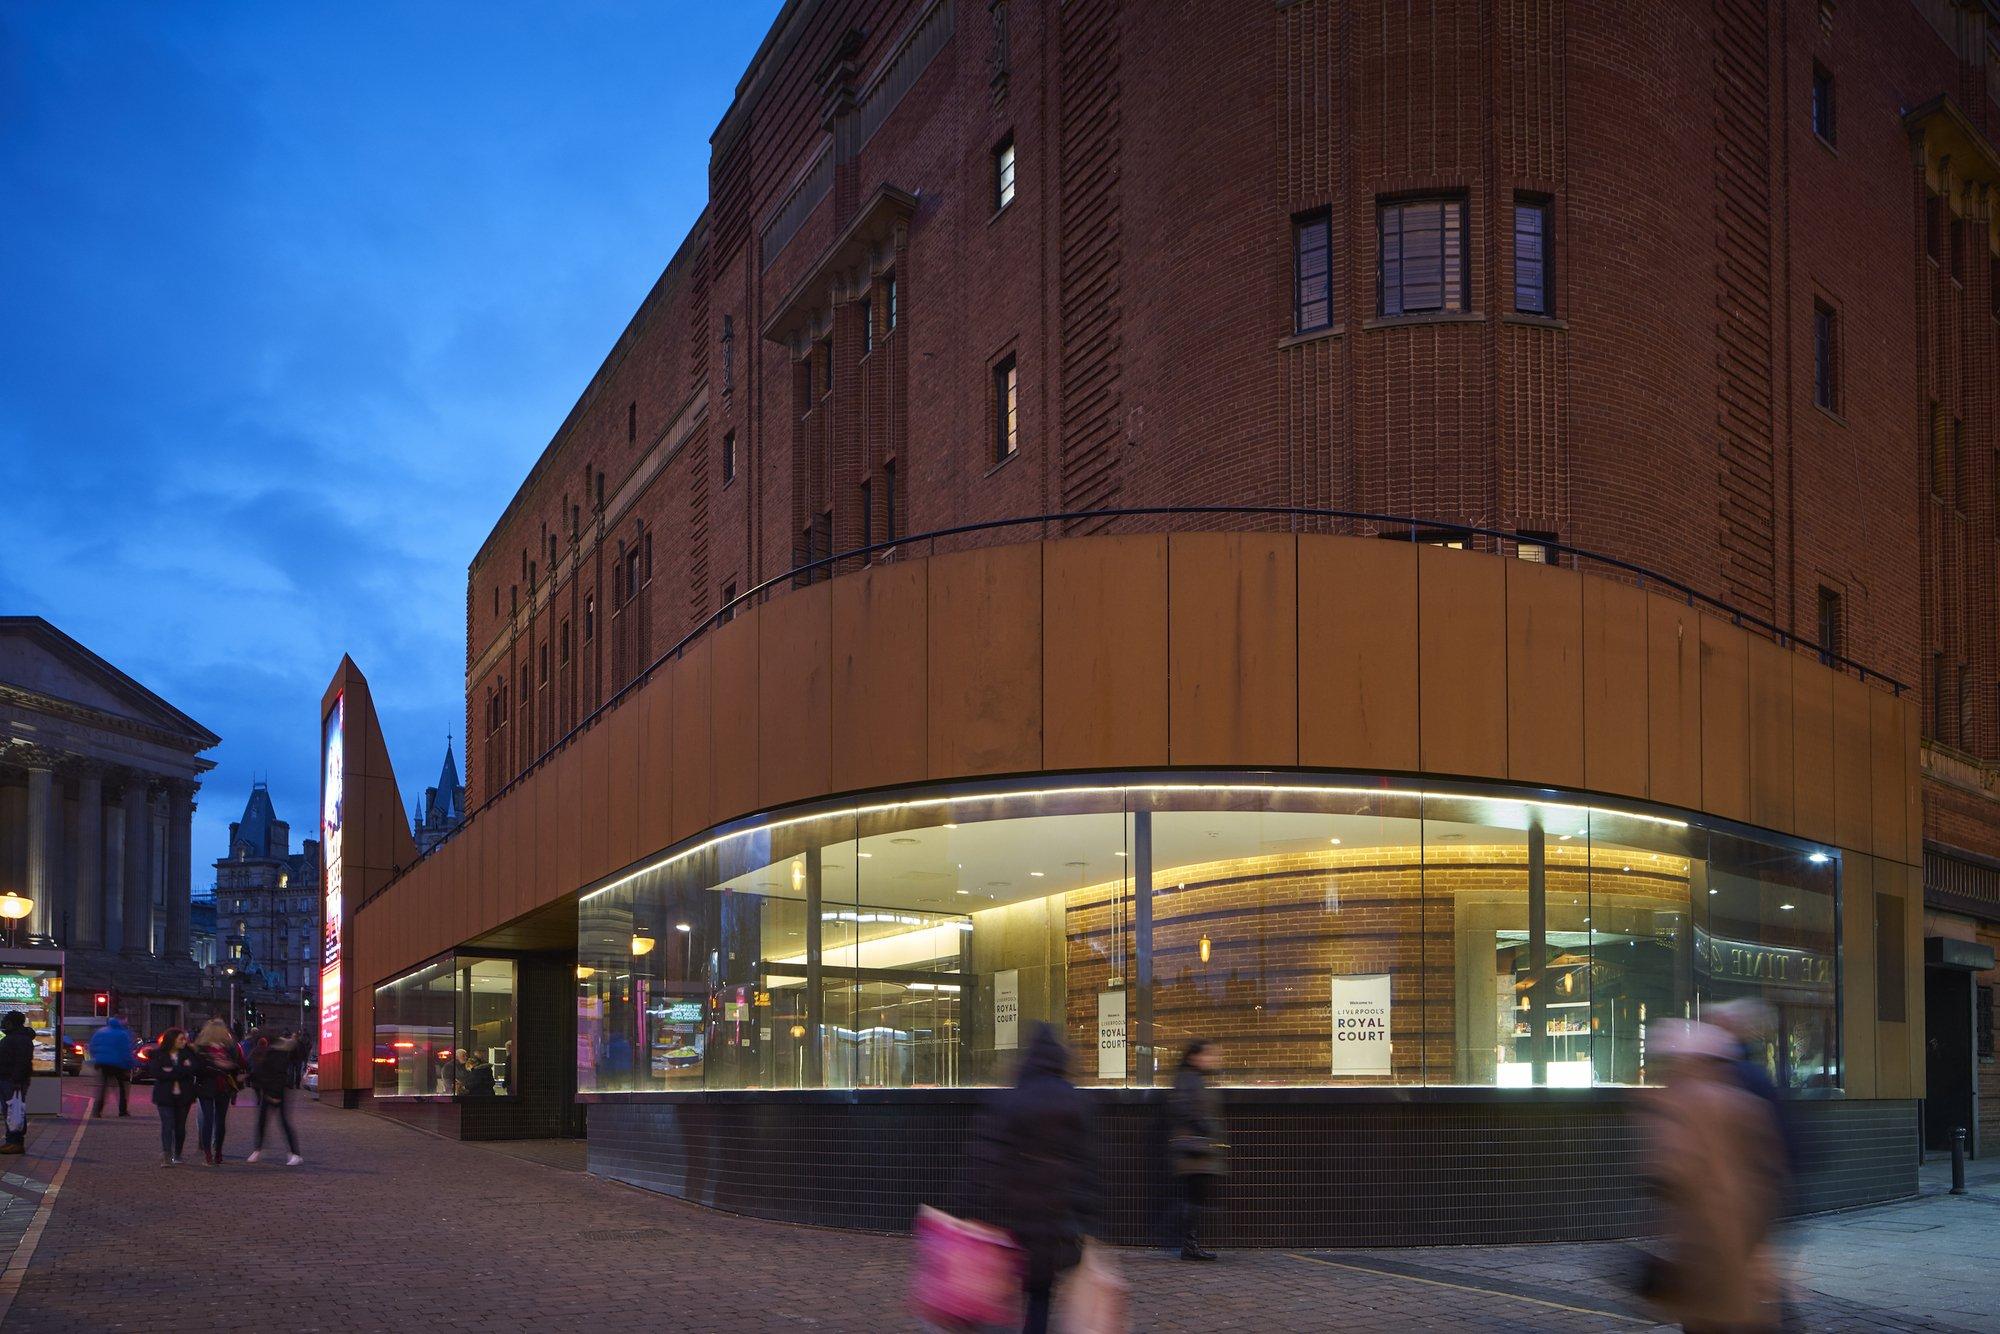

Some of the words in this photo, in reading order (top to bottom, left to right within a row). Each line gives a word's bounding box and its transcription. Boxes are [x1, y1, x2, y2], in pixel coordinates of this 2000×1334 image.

[996, 1004, 1017, 1013] ROYAL
[996, 1014, 1017, 1023] COURT
[1338, 1018, 1384, 1027] ROYAL
[1101, 1029, 1126, 1037] ROYAL
[1338, 1031, 1384, 1041] COURT
[1101, 1040, 1126, 1049] COURT
